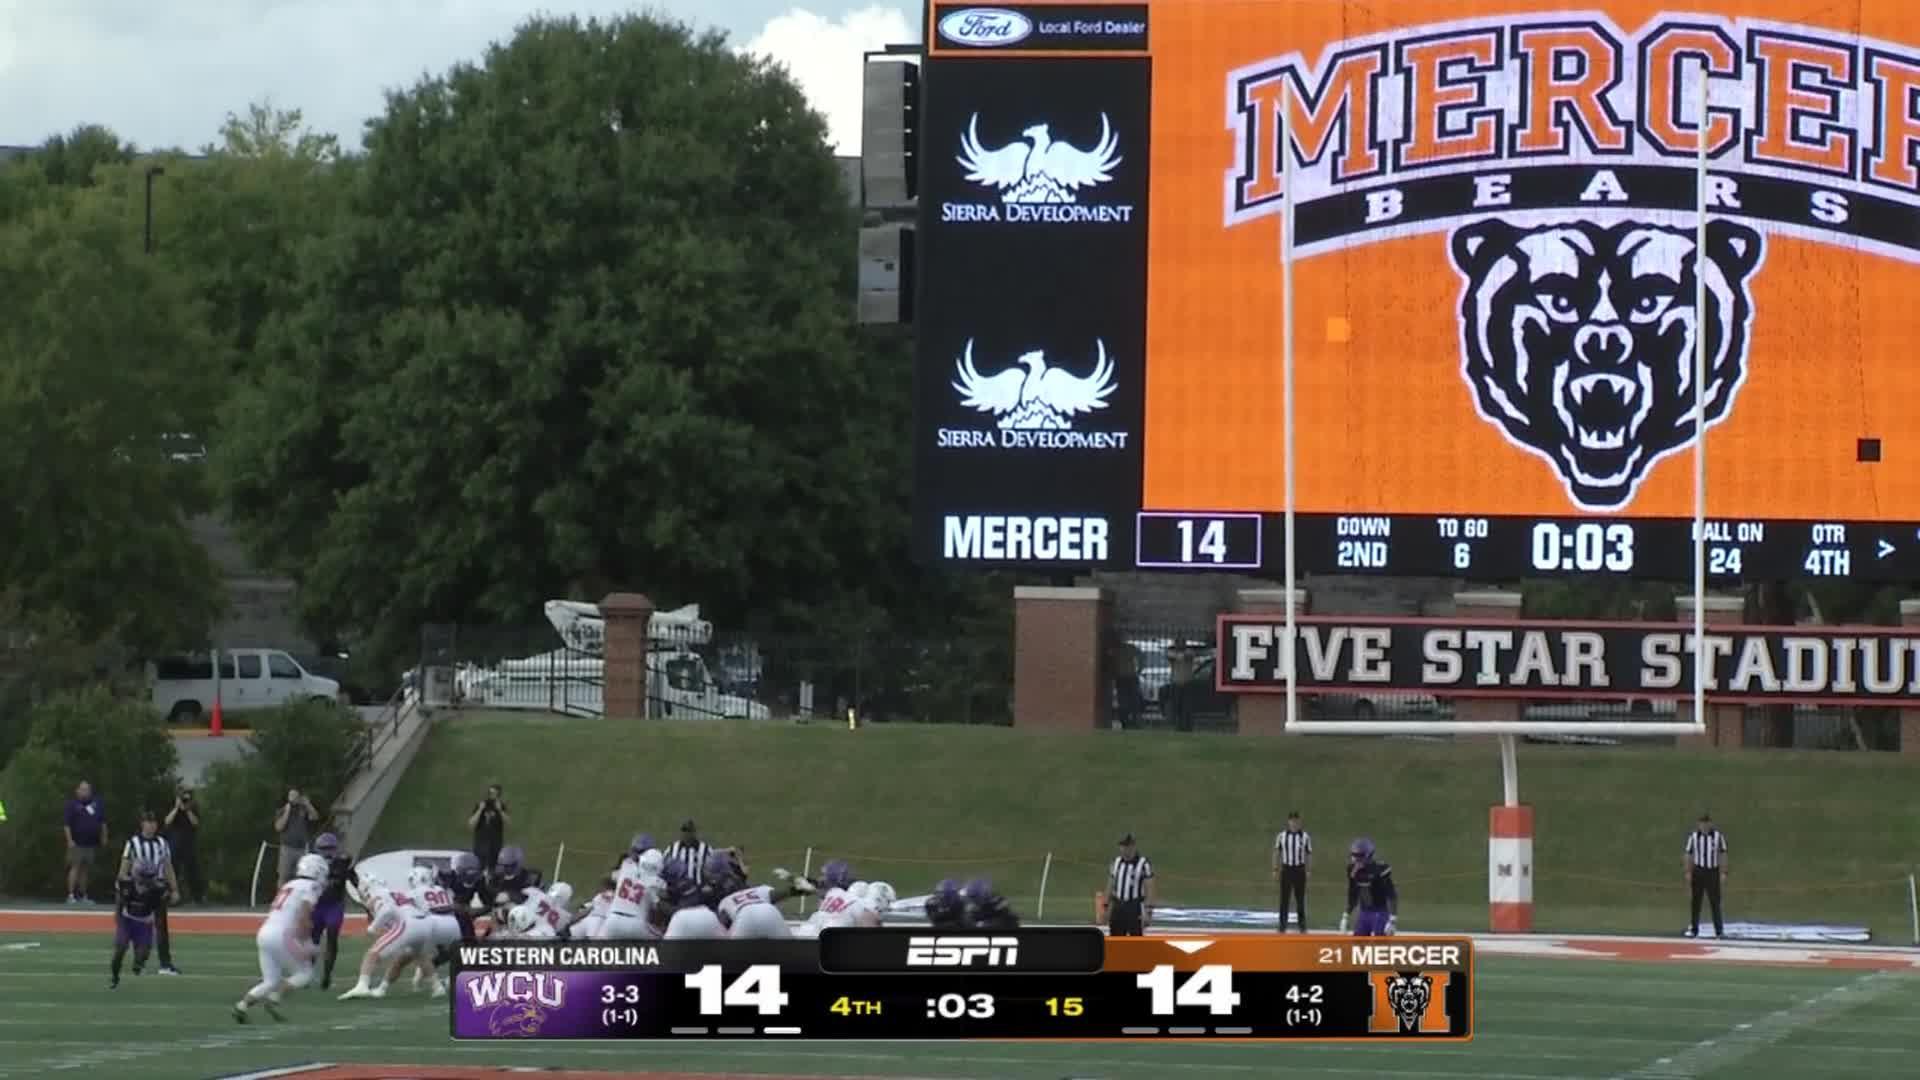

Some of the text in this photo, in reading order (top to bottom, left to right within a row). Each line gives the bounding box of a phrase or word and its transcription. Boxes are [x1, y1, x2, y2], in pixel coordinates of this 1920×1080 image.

[958, 15, 1012, 37] Ford
[1038, 21, 1146, 34] Local Ford Dealer
[1365, 171, 1849, 225] BEARS
[941, 203, 1133, 222] SIERRA DEVELOPMENT
[937, 428, 1129, 449] SIERRA DEVELOPMENT
[944, 515, 1109, 560] MERCER
[1337, 517, 1391, 537] DOWN
[1437, 518, 1488, 538] TO GO
[1737, 523, 1764, 542] ON
[1812, 524, 1845, 545] QTR
[1177, 519, 1227, 563] 14
[1532, 522, 1634, 572] 0:03
[1337, 541, 1388, 568] 2ND
[1454, 543, 1470, 569] 6
[1709, 548, 1742, 574] 24
[1804, 550, 1850, 576] 4TH
[1231, 625, 1920, 694] FIVE STAR STADIU
